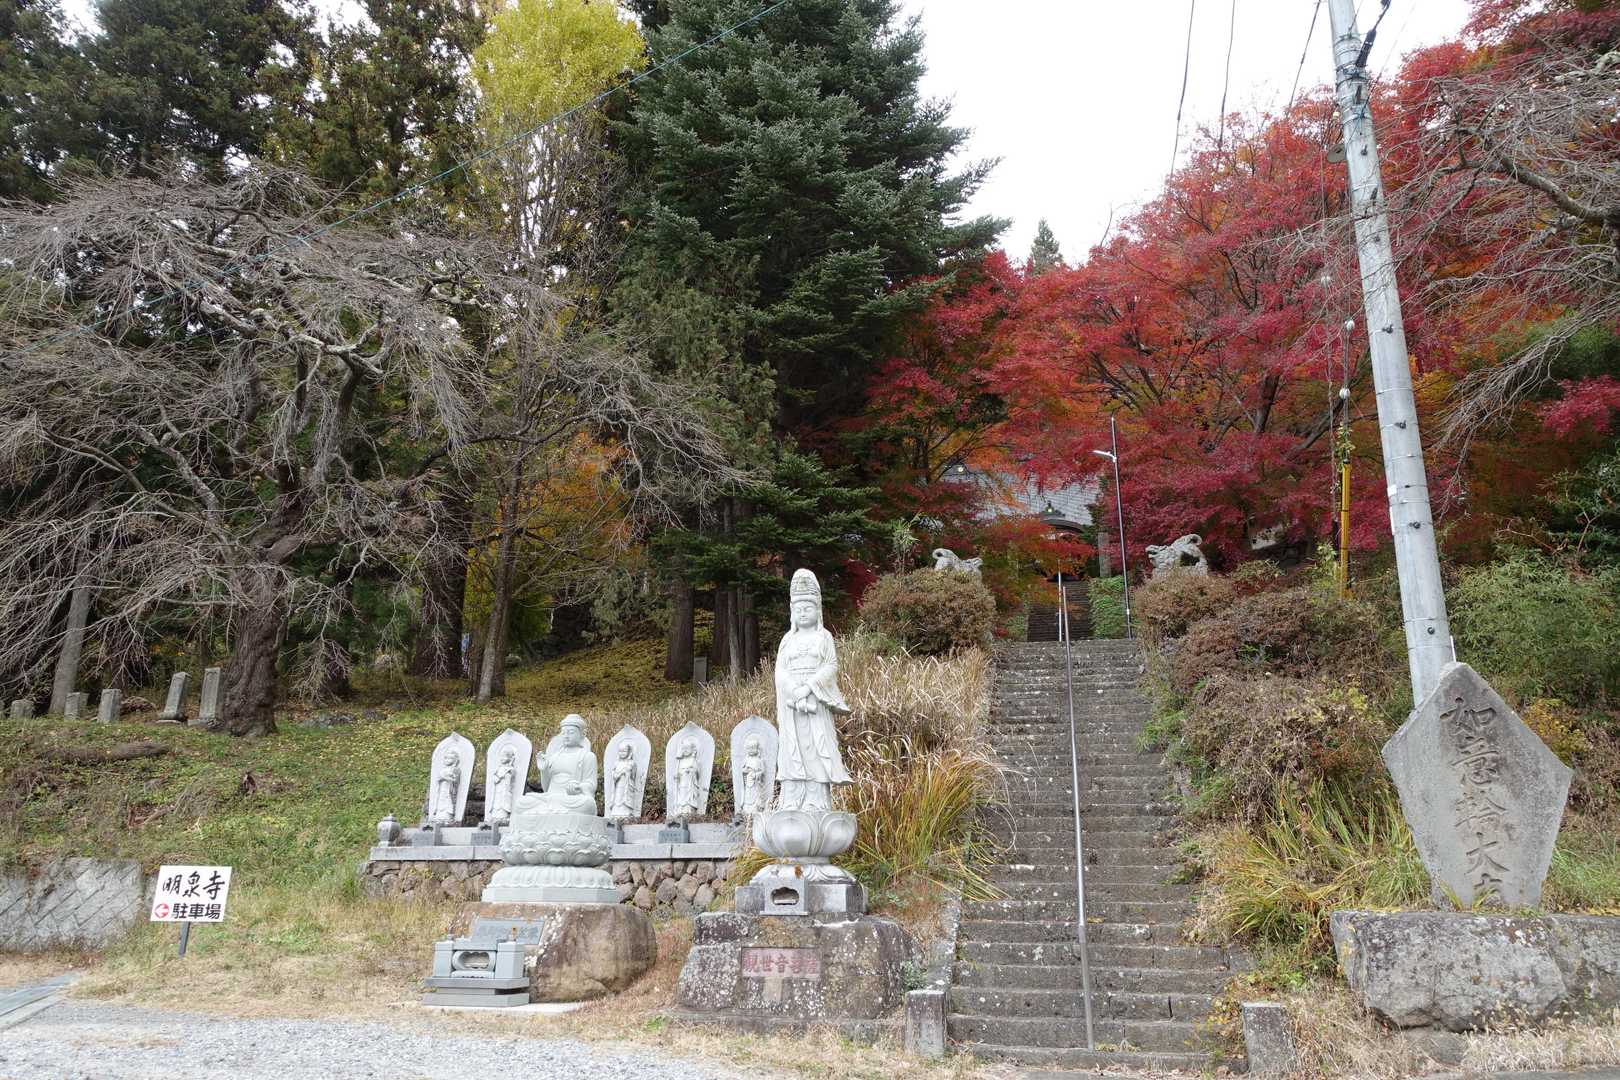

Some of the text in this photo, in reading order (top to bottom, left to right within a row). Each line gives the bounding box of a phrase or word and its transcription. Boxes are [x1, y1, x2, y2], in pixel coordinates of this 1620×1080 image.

[162, 870, 225, 900] 明泉寺
[172, 903, 222, 919] 駐車場
